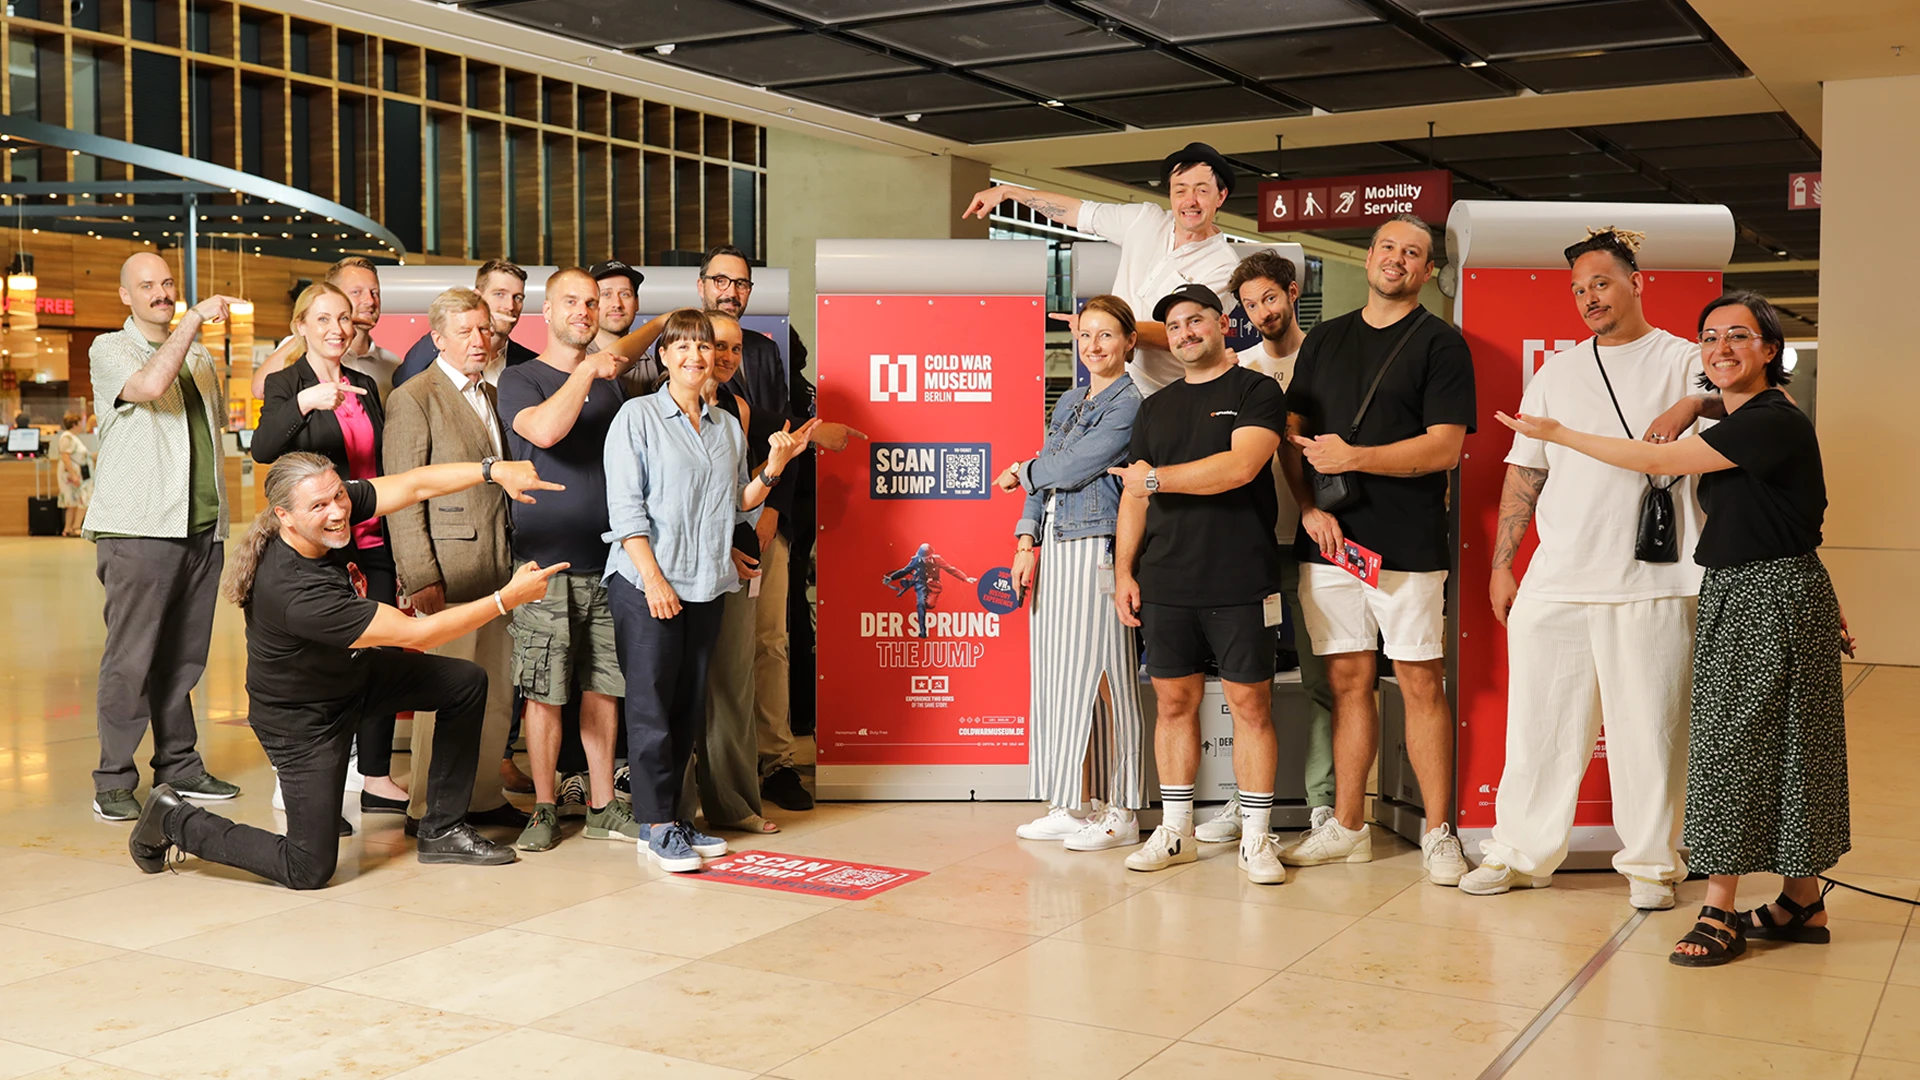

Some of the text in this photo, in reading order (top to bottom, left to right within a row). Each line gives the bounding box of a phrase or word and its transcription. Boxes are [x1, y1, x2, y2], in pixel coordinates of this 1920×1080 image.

[1365, 183, 1422, 200] Mobility
[1364, 200, 1412, 215] Service
[36, 298, 74, 315] FREE
[924, 354, 992, 371] COLD WAR
[924, 372, 992, 390] MUSEUM
[924, 392, 952, 402] BERLIN
[876, 448, 935, 472] SCAN
[876, 476, 936, 494] & JUMP
[998, 578, 1008, 589] VR
[982, 593, 1014, 609] EXPERIENCE
[860, 612, 1000, 638] DER SPRUNG
[876, 641, 985, 668] THE JUMP
[958, 727, 1025, 736] COLDWARMUSEUM.DE
[1219, 737, 1234, 747] DER
[710, 862, 806, 879] & JUMP
[734, 854, 832, 873] SCAN
